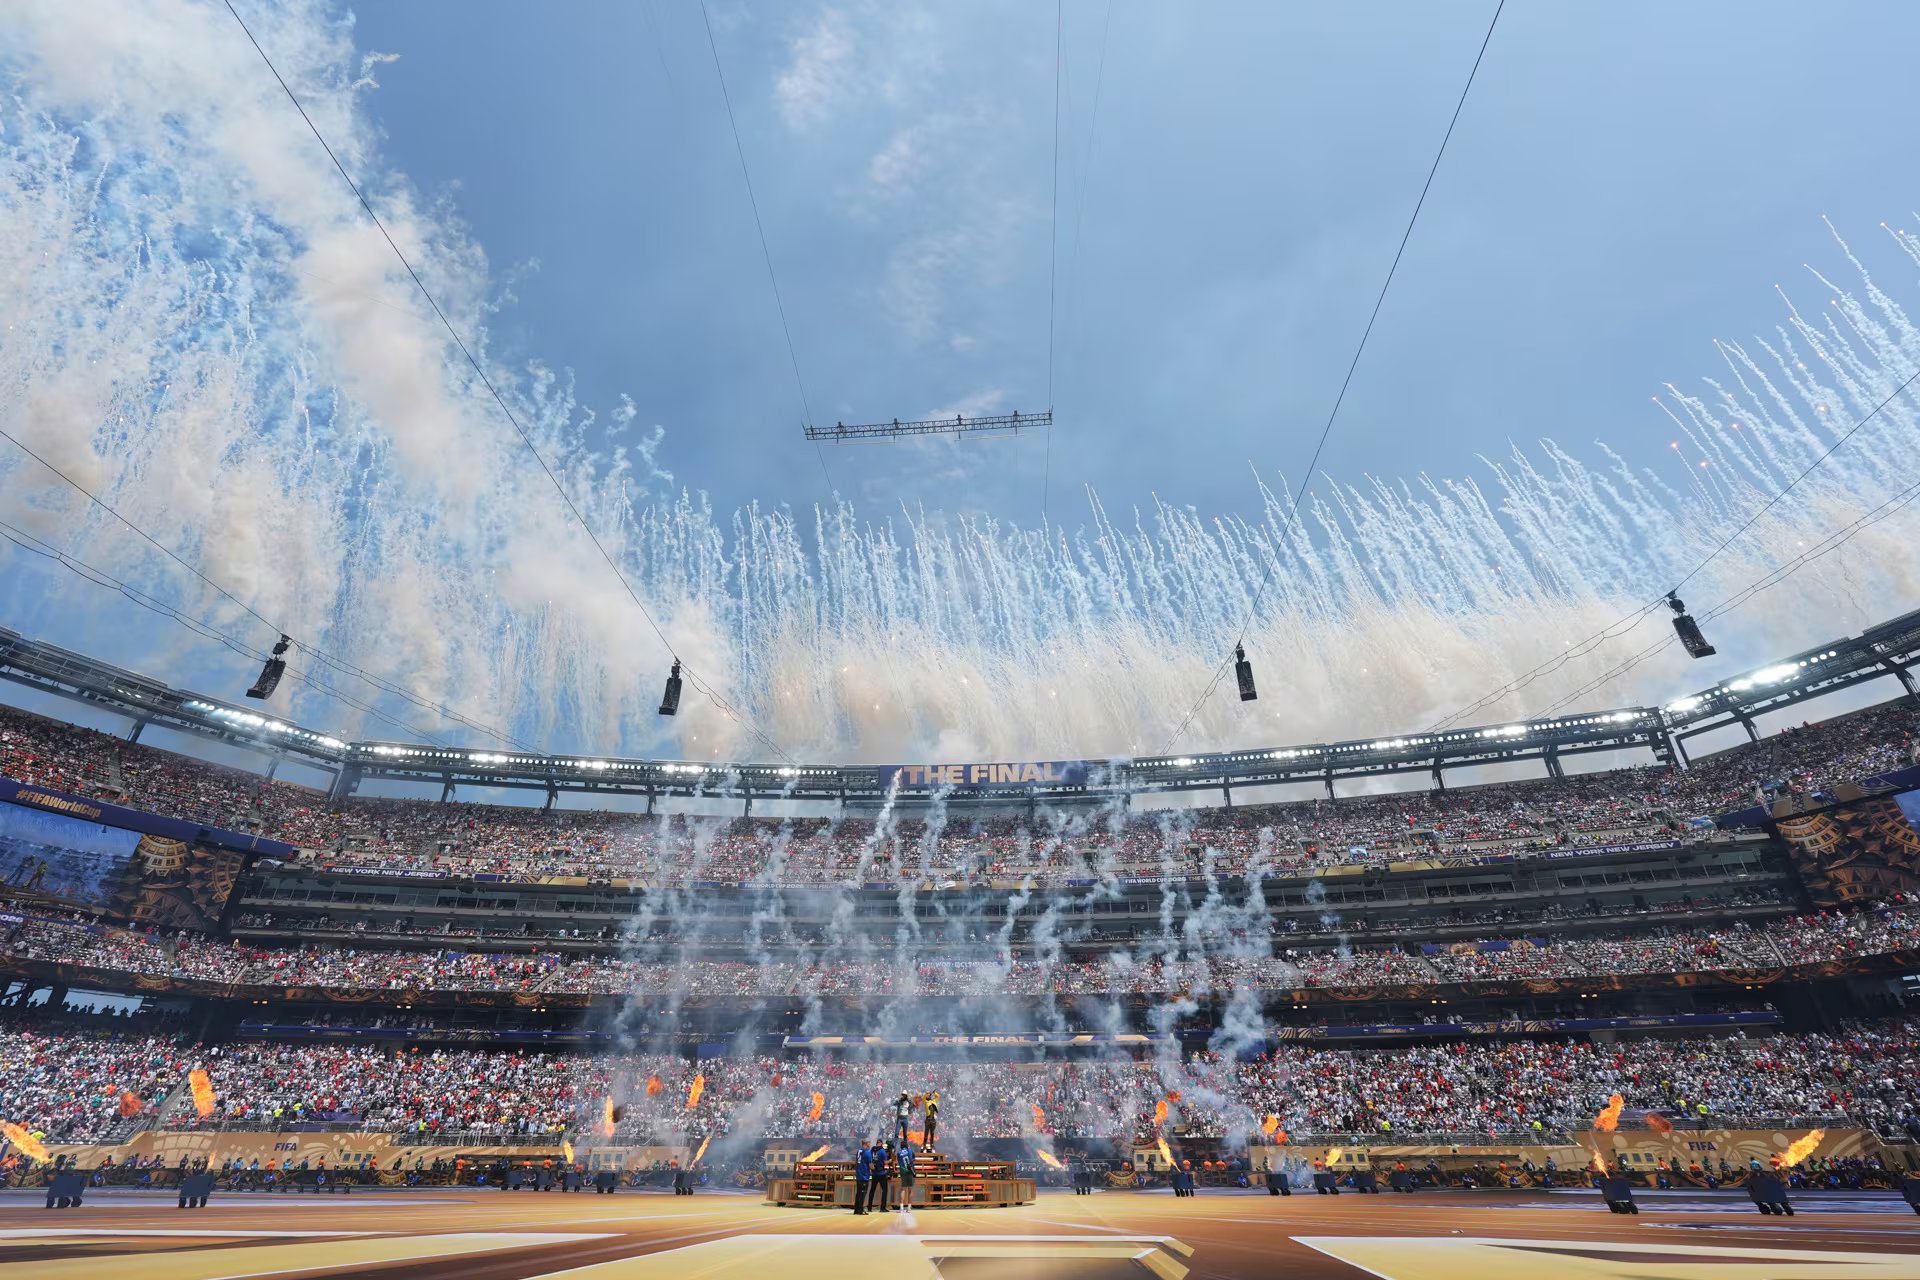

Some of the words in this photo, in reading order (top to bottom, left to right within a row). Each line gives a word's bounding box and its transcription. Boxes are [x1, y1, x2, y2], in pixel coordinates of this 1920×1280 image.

[903, 766, 964, 785] THE
[970, 762, 1062, 785] FINAL
[16, 789, 101, 818] #FIFAWorldCup
[1632, 842, 1675, 851] JERSEY
[404, 870, 441, 878] JERSEY
[273, 1142, 297, 1151] FIFA
[1687, 1141, 1717, 1151] FIFA
